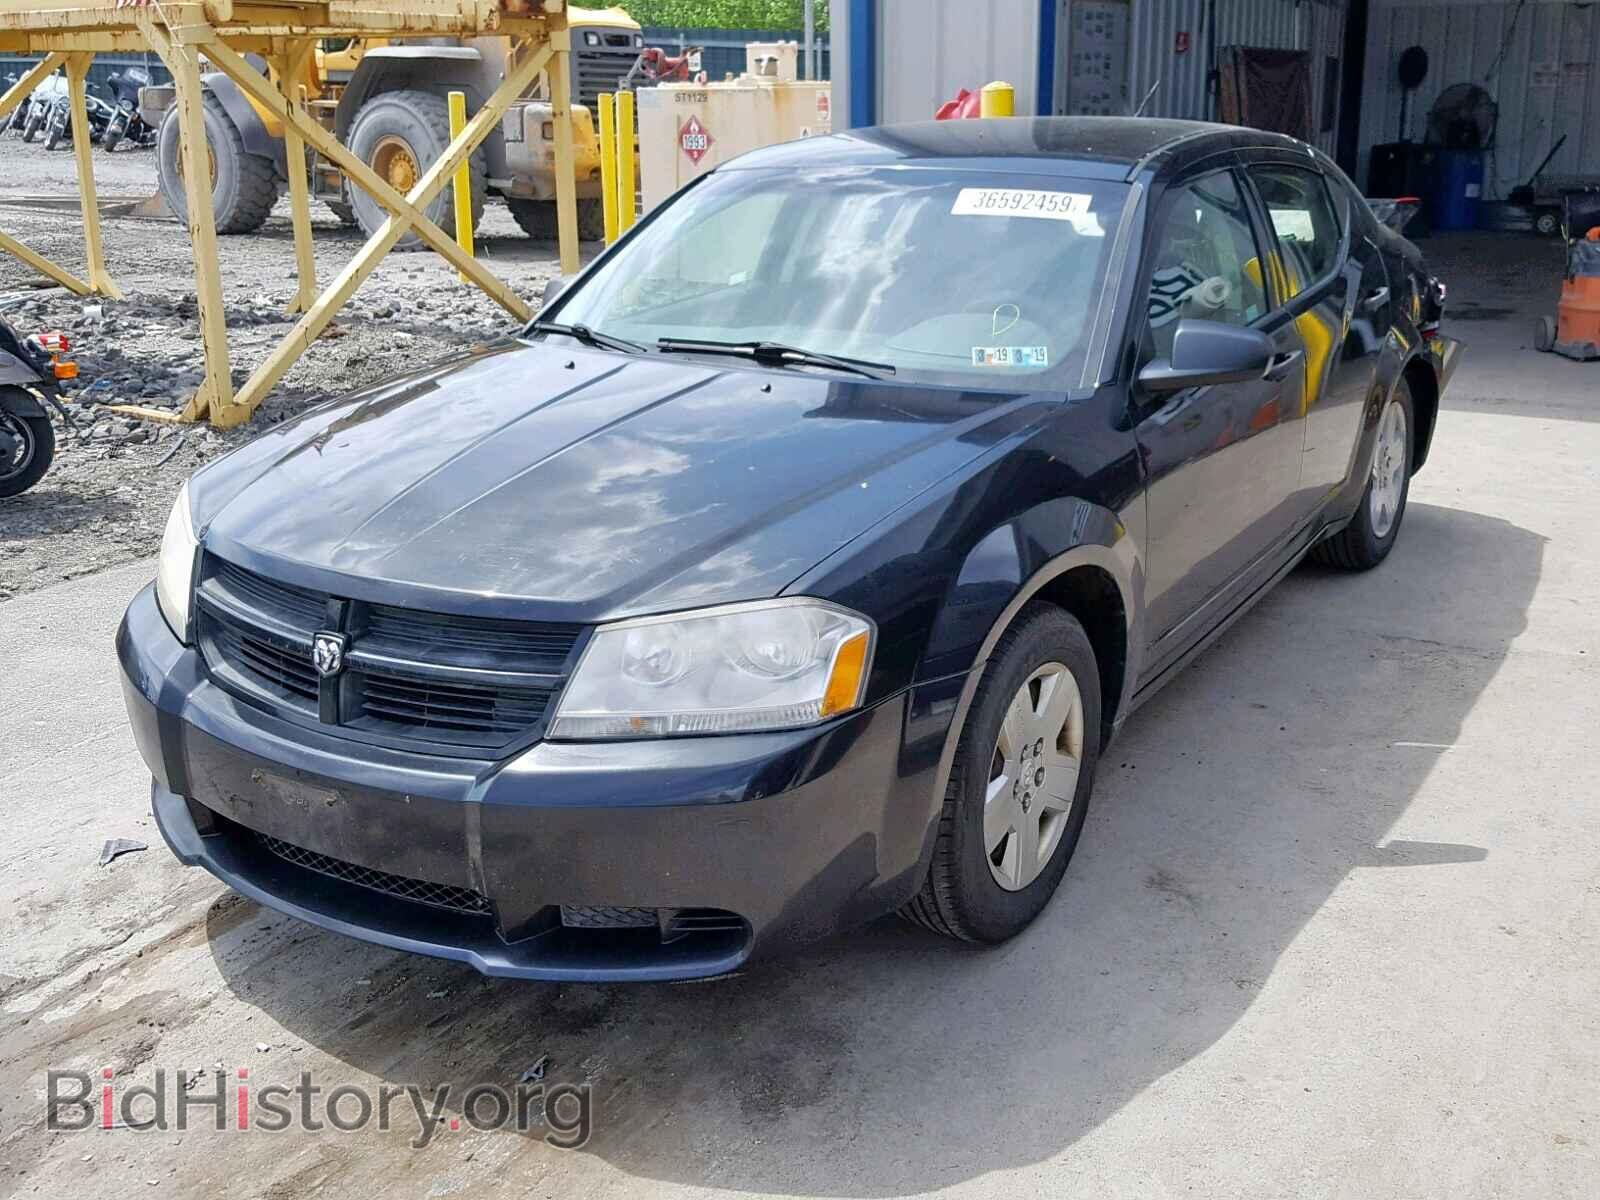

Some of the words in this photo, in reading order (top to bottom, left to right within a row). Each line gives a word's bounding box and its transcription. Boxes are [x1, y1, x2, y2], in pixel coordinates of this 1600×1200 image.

[675, 93, 707, 103] ST1129
[684, 136, 705, 149] 1993
[974, 191, 1072, 213] 36592459
